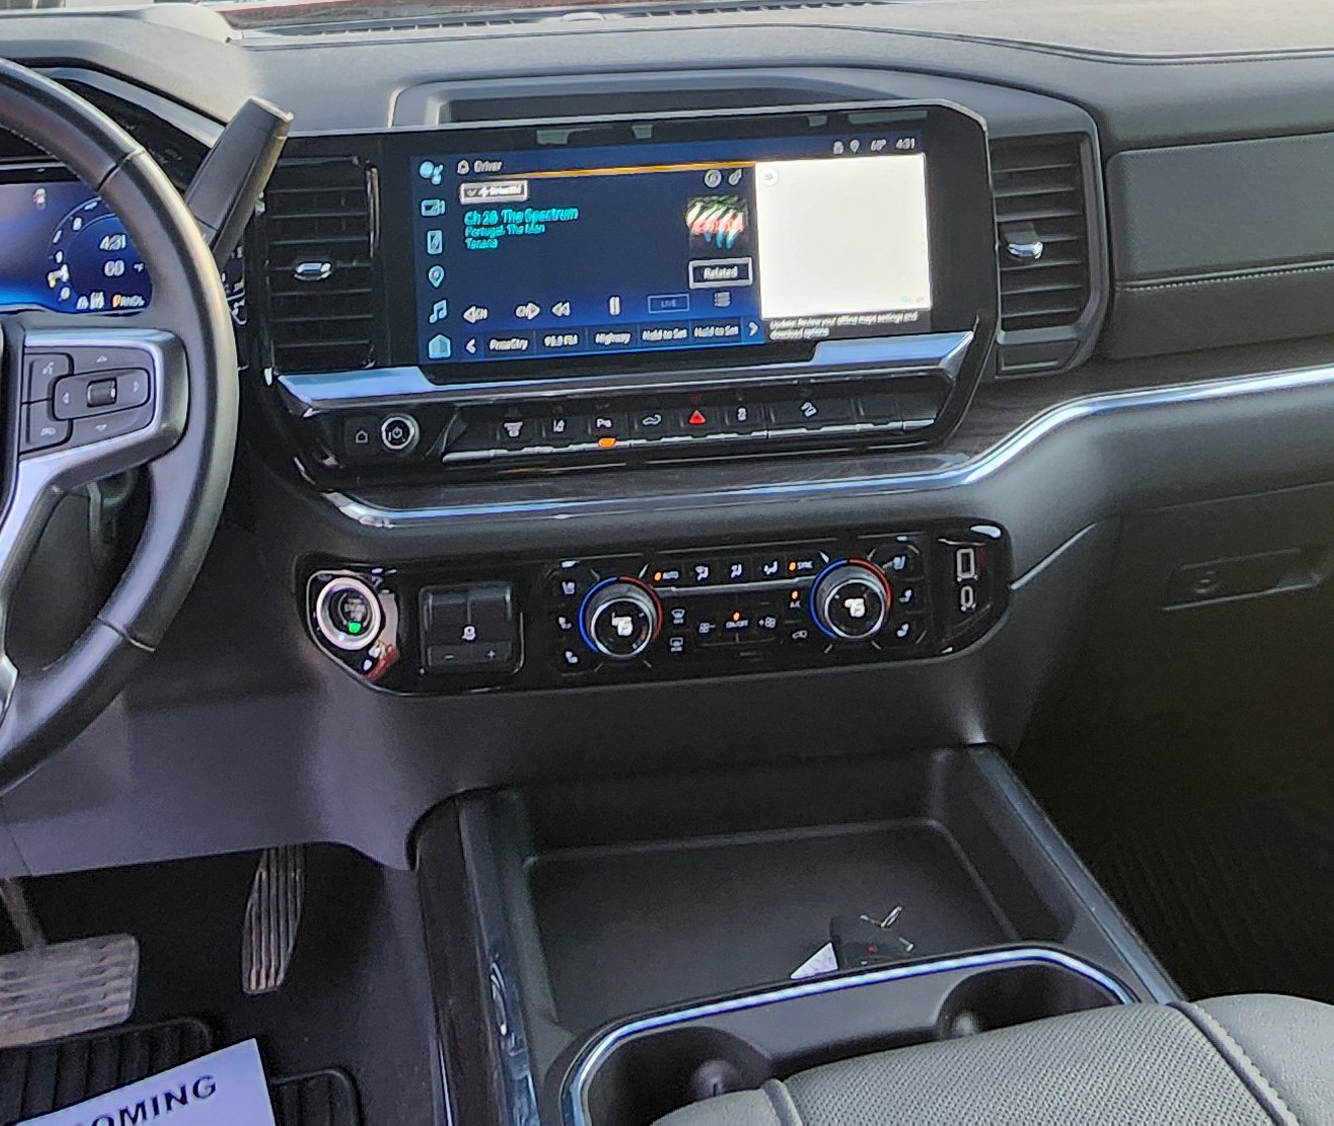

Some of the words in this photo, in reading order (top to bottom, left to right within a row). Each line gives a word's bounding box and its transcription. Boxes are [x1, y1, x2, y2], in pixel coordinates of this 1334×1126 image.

[474, 160, 503, 173] Driver
[464, 210, 482, 225] Ch
[501, 209, 524, 223] The
[525, 207, 579, 224] Spectrum
[507, 223, 524, 235] The
[703, 265, 738, 280] Related
[661, 298, 678, 307] LIVE
[641, 329, 663, 341] Hold
[662, 330, 672, 340] to
[672, 328, 687, 339] Set
[693, 326, 714, 338] Hold
[714, 327, 724, 337] to
[724, 325, 739, 336] Set
[595, 332, 631, 346] Highway
[76, 1075, 217, 1126] OMING
